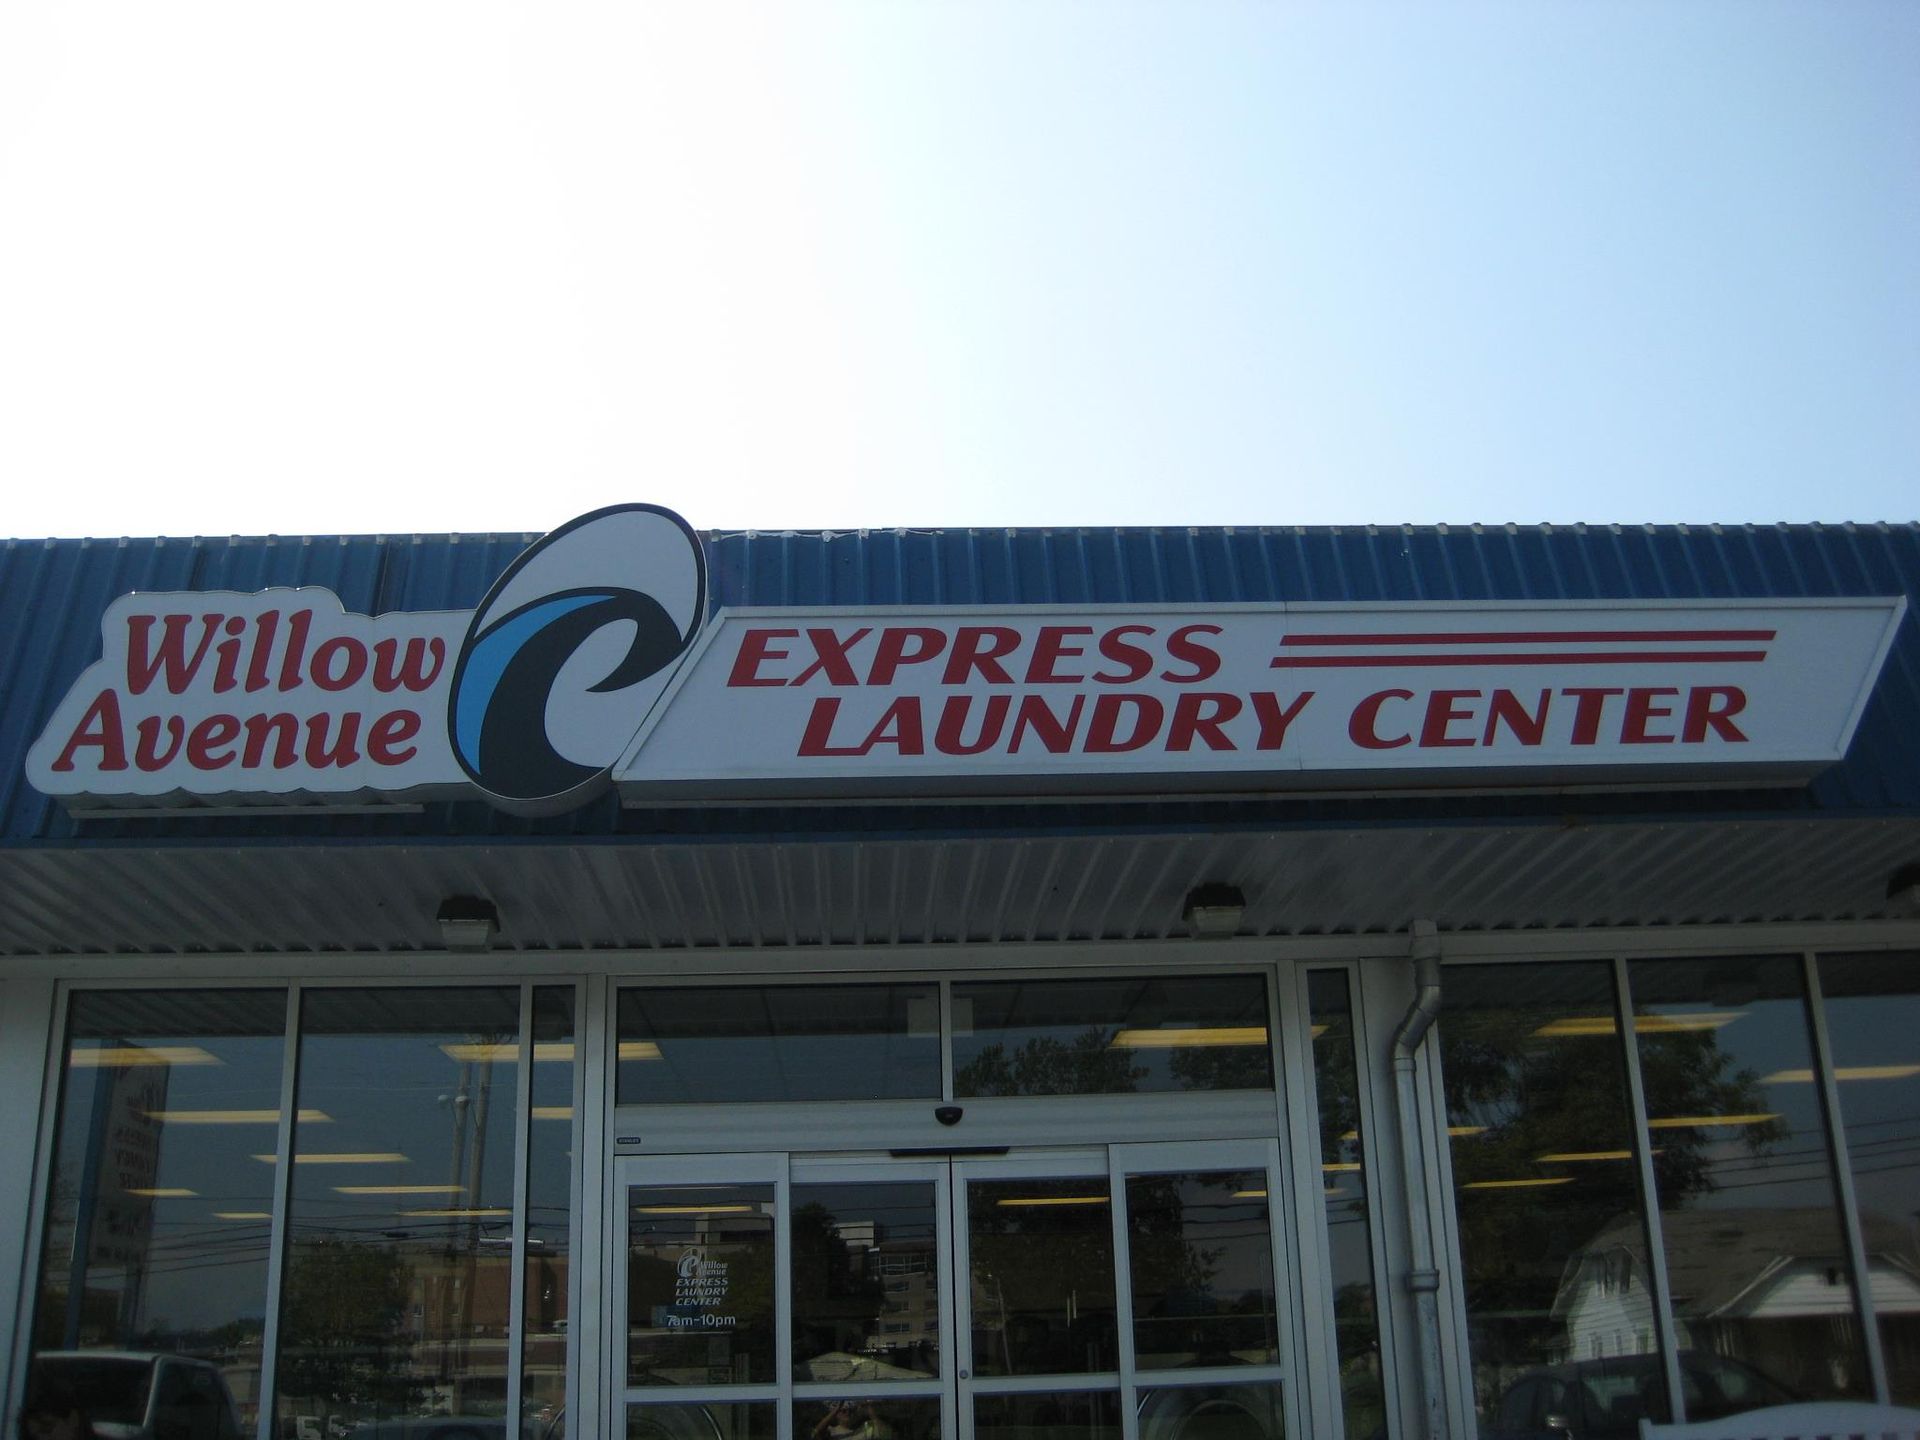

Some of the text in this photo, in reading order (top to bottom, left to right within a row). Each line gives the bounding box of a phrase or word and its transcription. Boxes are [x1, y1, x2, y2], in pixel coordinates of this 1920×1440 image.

[127, 609, 446, 695] Willow
[726, 624, 1224, 687] EXPRESS
[51, 689, 421, 772] Avenue
[797, 685, 1749, 757] LAUNDRY CENTER
[675, 1287, 728, 1297] LAUNDRY
[675, 1297, 721, 1306] CENTER
[676, 1278, 728, 1287] EXPRESS
[666, 1313, 736, 1328] 7am-10pm
